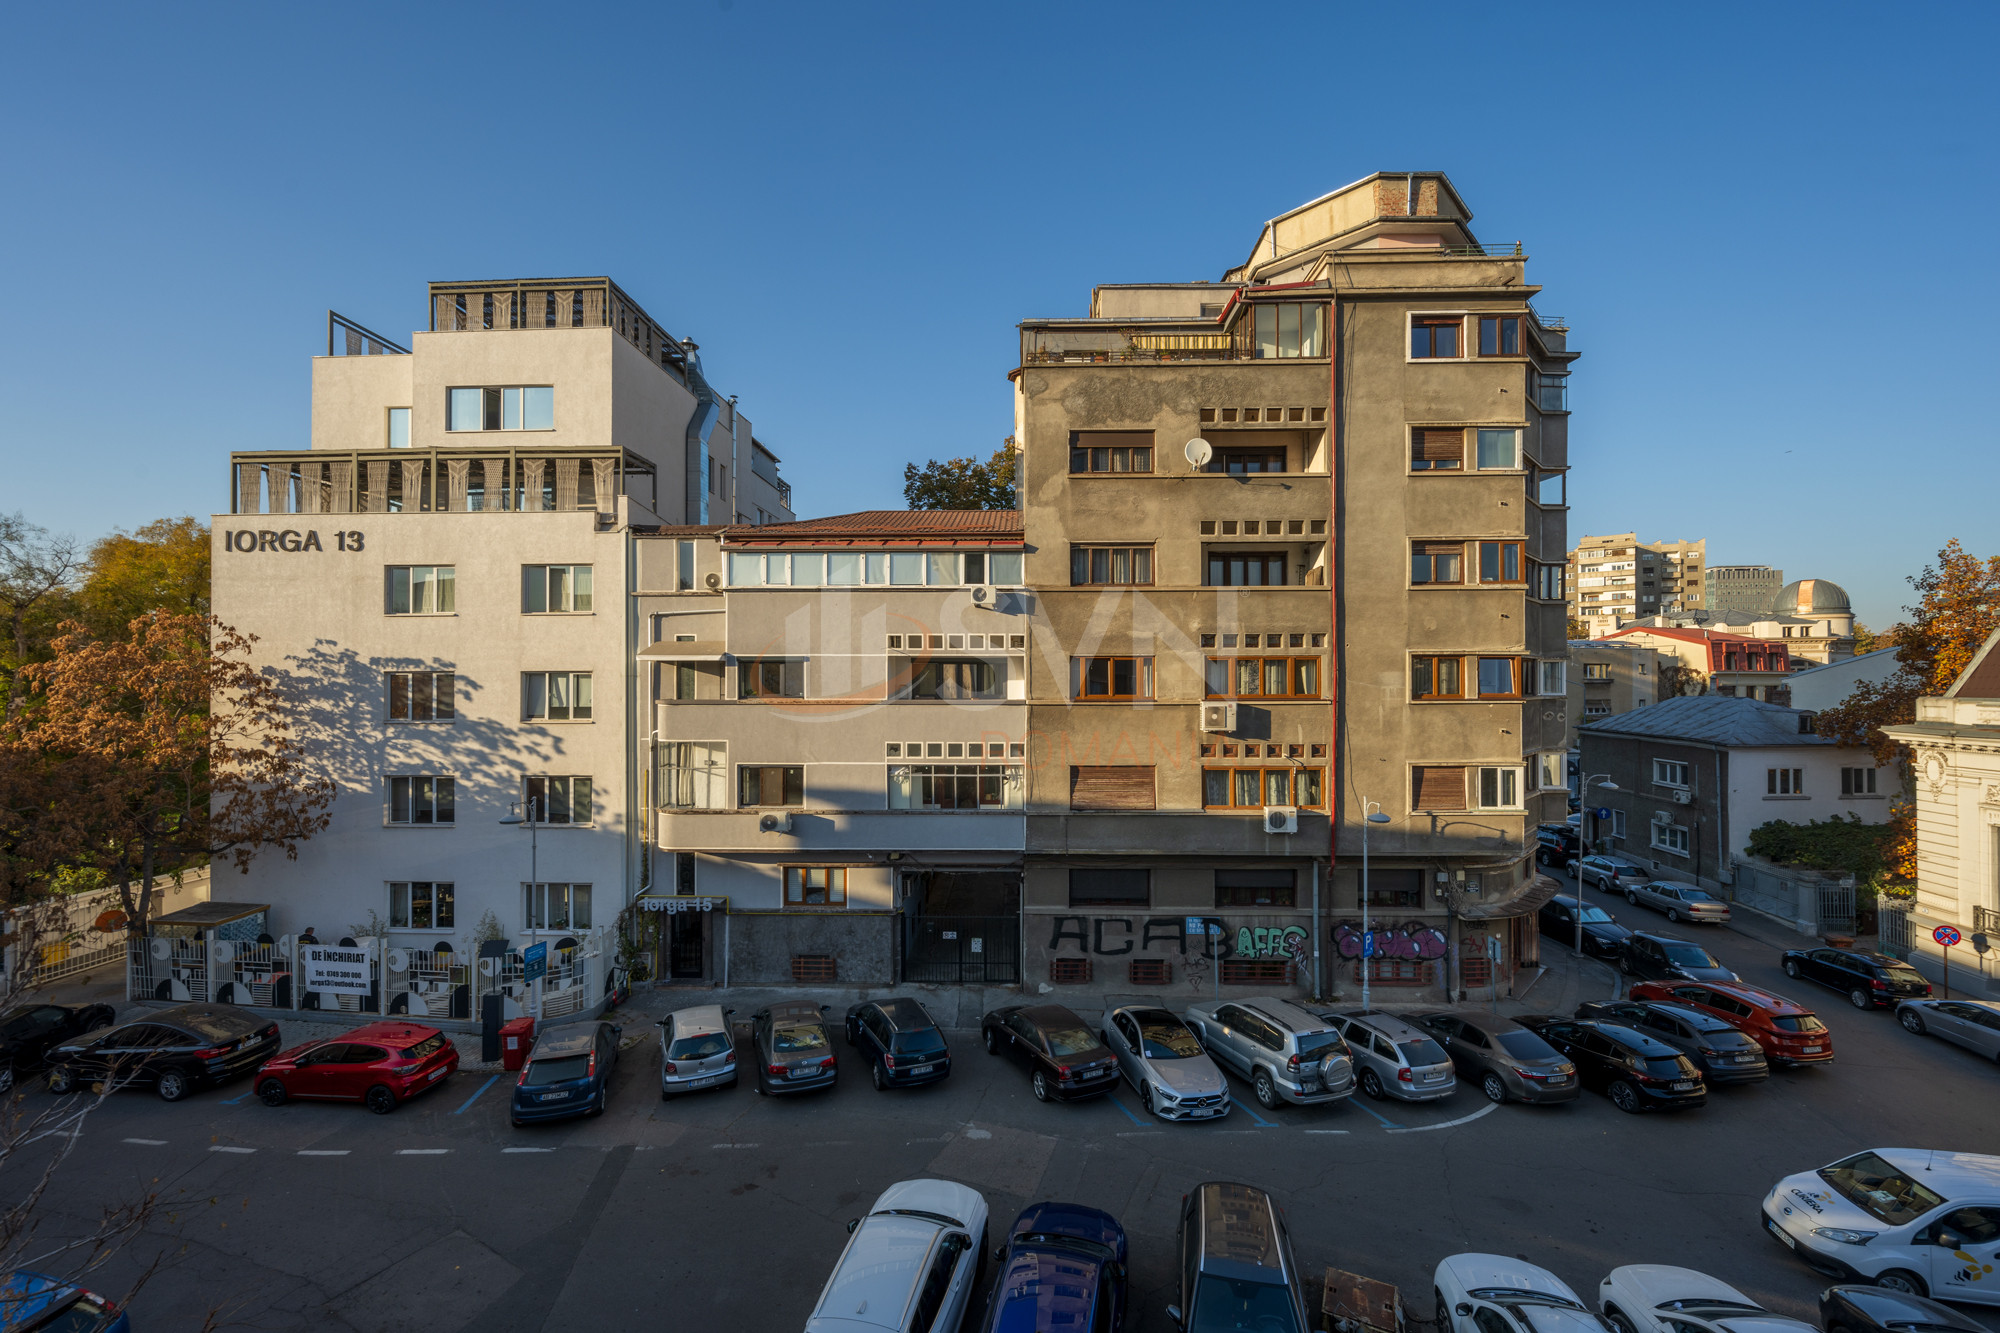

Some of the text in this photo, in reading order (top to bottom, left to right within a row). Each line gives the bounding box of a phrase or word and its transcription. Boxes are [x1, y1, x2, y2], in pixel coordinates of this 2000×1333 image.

[225, 529, 365, 552] IORGA 13
[692, 896, 713, 912] 15
[1049, 916, 1234, 960] ACAB
[1365, 934, 1372, 950] P
[312, 950, 365, 963] DE ÎNCHIRIAT
[1791, 1188, 1824, 1214] CURIERA
